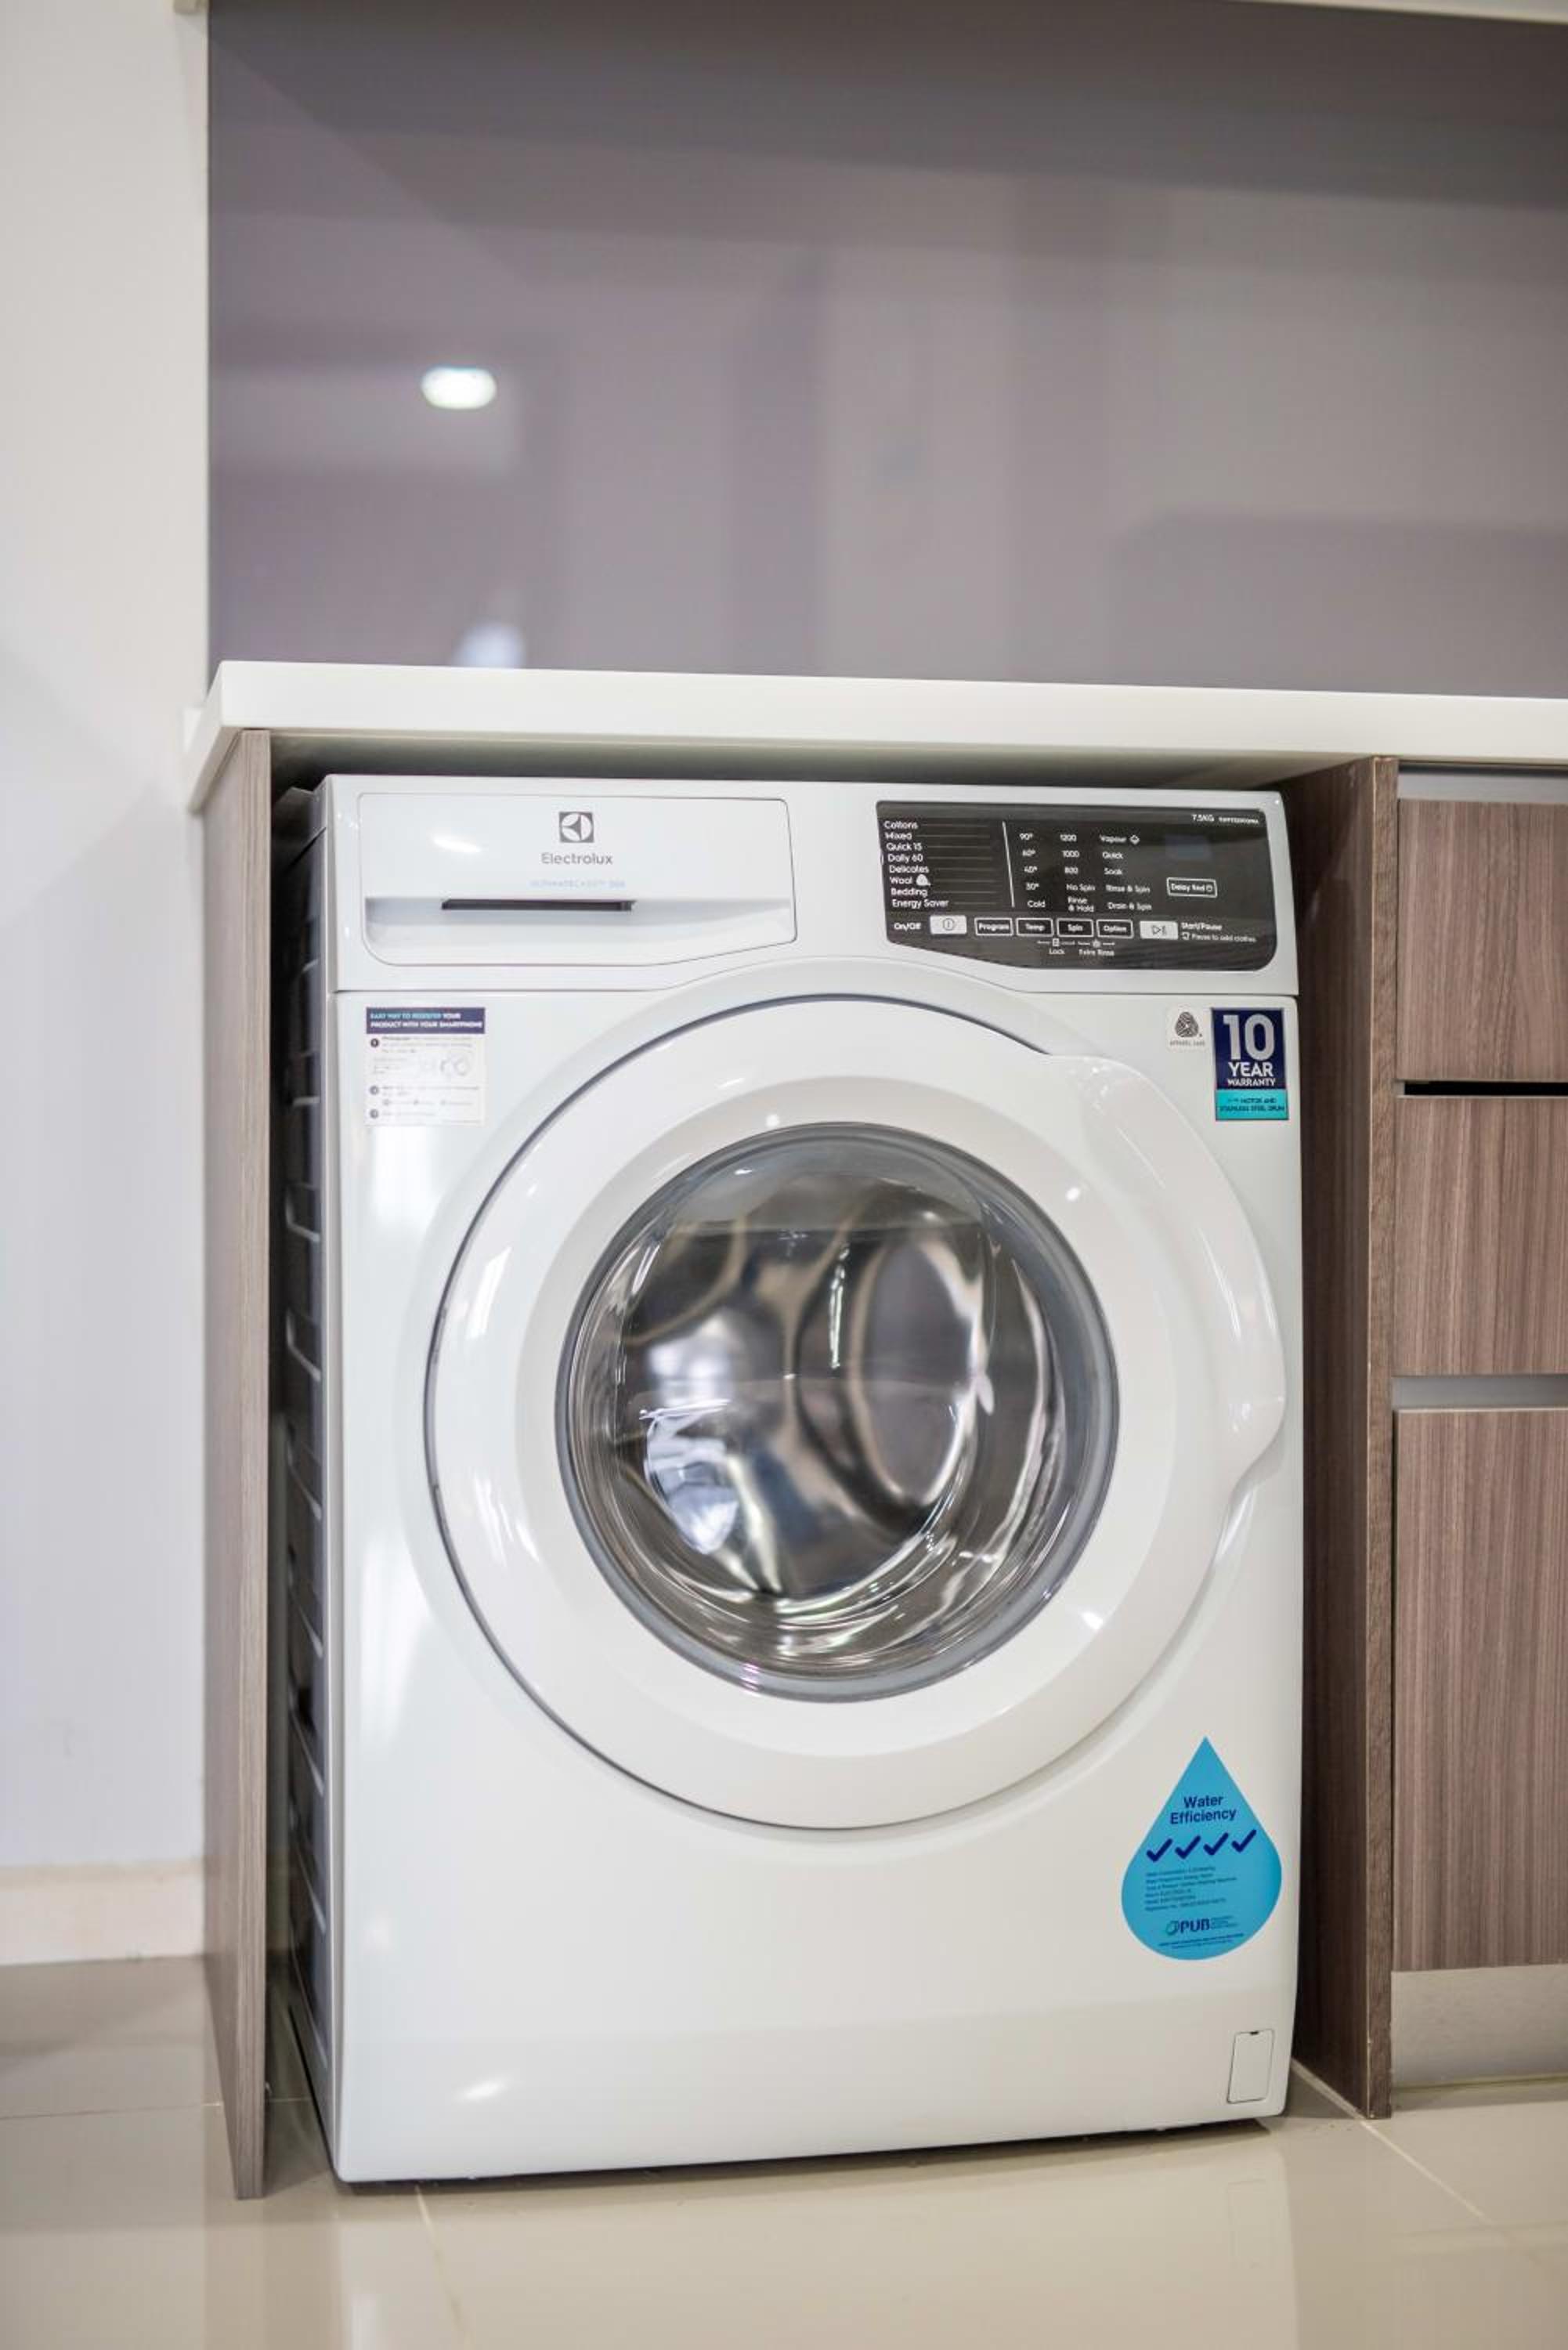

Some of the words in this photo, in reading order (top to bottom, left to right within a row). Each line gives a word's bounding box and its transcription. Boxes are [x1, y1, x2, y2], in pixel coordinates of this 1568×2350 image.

[883, 821, 918, 830] Cottons
[1100, 834, 1127, 844] Vapour
[886, 842, 911, 851] Quick
[912, 842, 923, 851] 15
[540, 851, 613, 865] Electrolux
[887, 854, 910, 863] Daily
[912, 854, 923, 862] 60
[889, 865, 930, 873] Delicates
[890, 876, 912, 884] Wool
[1079, 884, 1096, 892] Spin
[1135, 885, 1151, 894] Spin
[1171, 883, 1190, 892] Delay
[891, 888, 928, 898] Bedding
[892, 898, 922, 909] Energy
[923, 898, 949, 907] Saver
[1068, 895, 1088, 904] Rinse
[1076, 904, 1094, 913] Hold
[1136, 902, 1152, 911] Spin
[894, 922, 922, 931] On/Off
[978, 923, 1010, 932] Program
[1025, 923, 1046, 931] Temp
[1068, 924, 1083, 932] Spin
[1104, 924, 1127, 933] Option
[1180, 922, 1223, 931] Start/Pause
[1223, 1014, 1275, 1061] 10
[1228, 1061, 1274, 1077] YEAR
[1227, 1078, 1276, 1086] WARRANTY
[1183, 1795, 1223, 1809] Water
[1169, 1808, 1237, 1825] Efficiency
[1180, 1918, 1210, 1933] PUB
